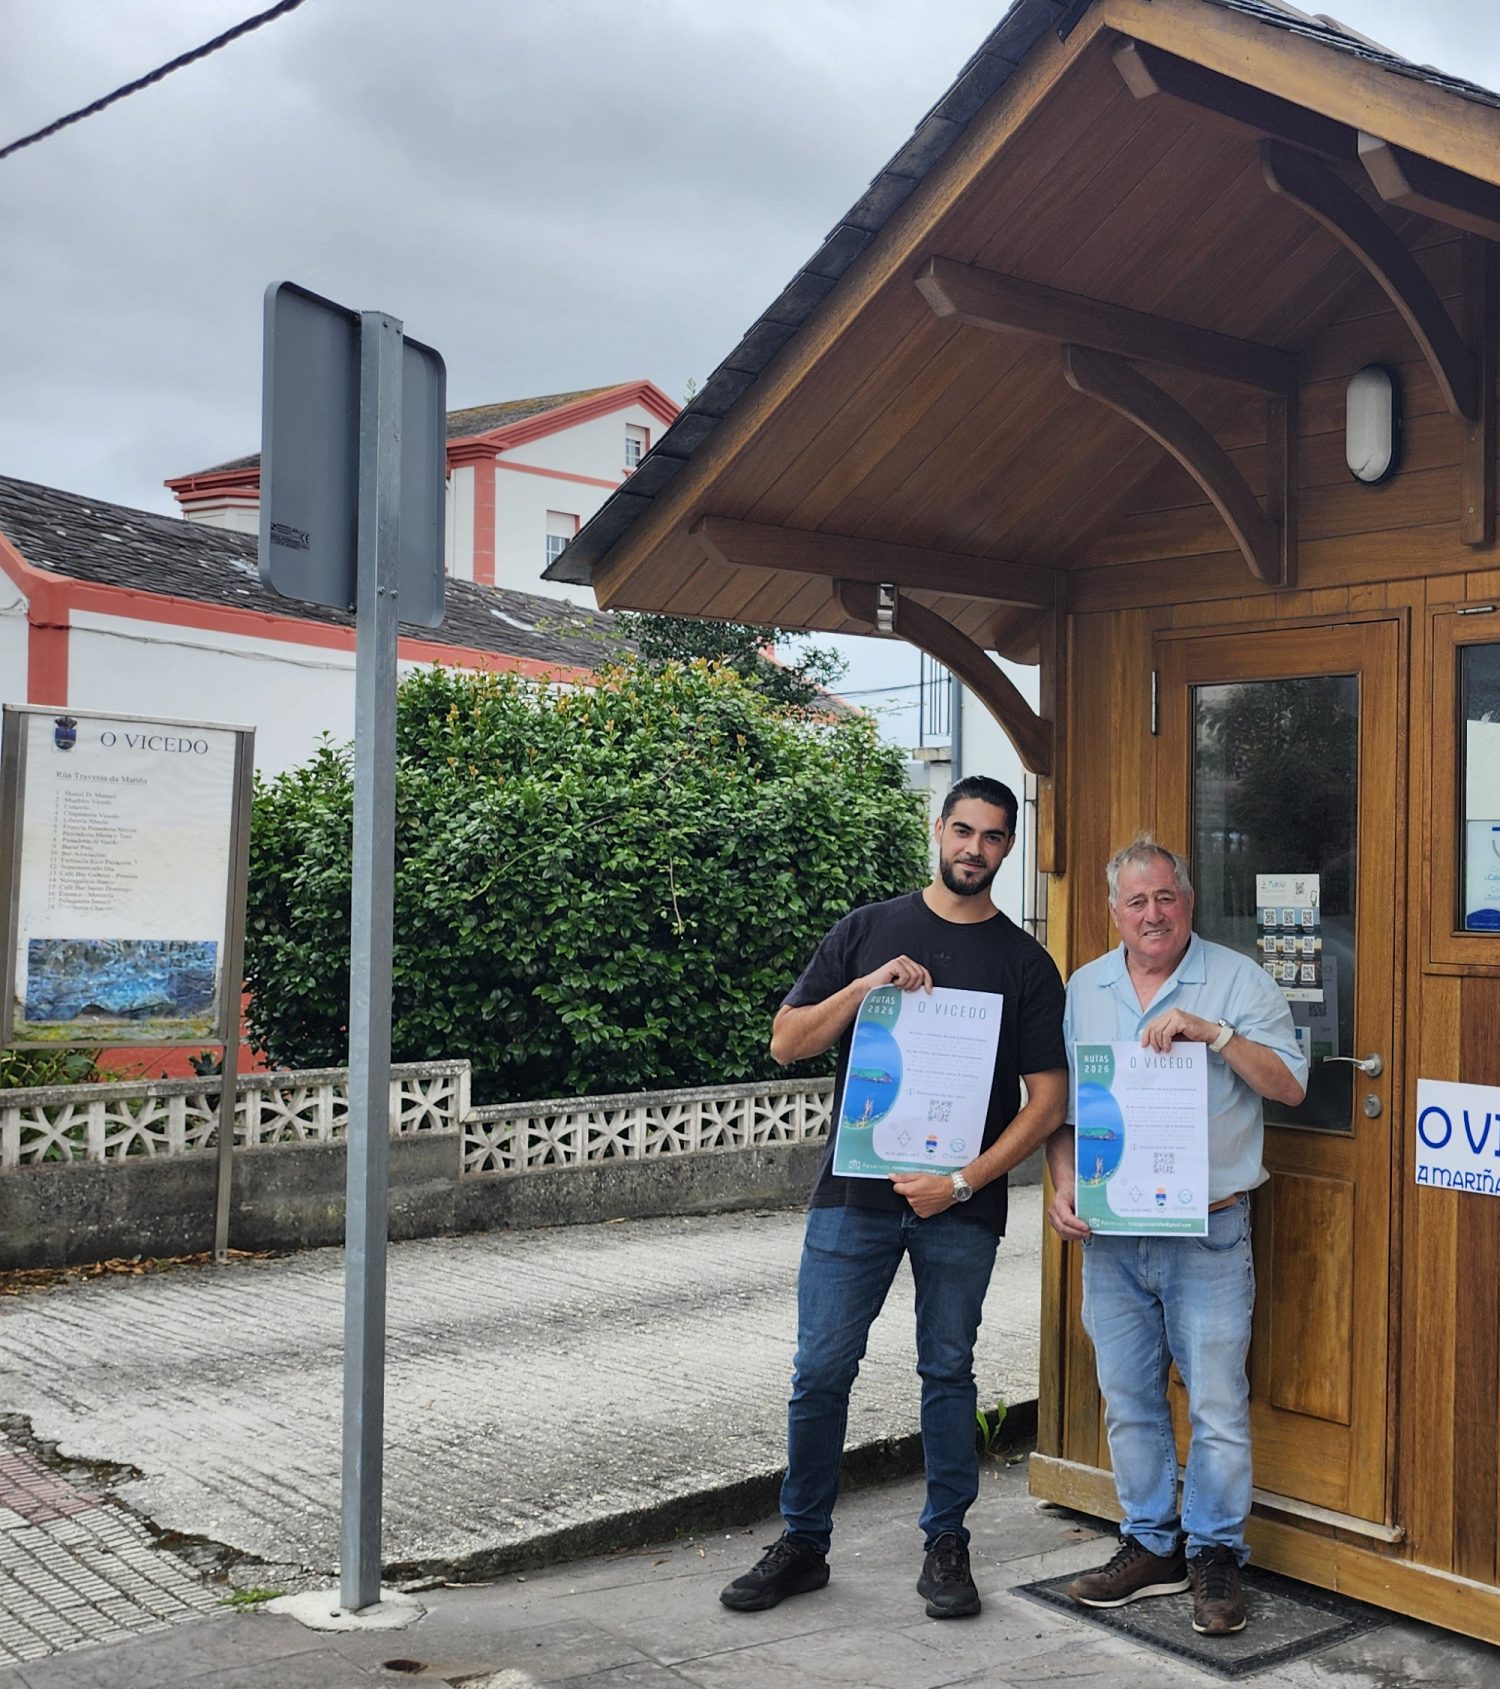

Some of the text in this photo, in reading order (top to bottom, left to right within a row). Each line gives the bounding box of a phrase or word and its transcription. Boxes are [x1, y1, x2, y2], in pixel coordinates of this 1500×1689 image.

[100, 732, 209, 755] O VICEDO
[871, 995, 896, 1005] RUTAS
[868, 1005, 894, 1015] 2026
[918, 1001, 987, 1020] O VICEDO
[1084, 1055, 1109, 1063] RUTAS
[1130, 1057, 1193, 1069] O VICEDO
[1084, 1065, 1109, 1073] 2026
[1418, 1106, 1452, 1149] O
[1417, 1165, 1428, 1183] A
